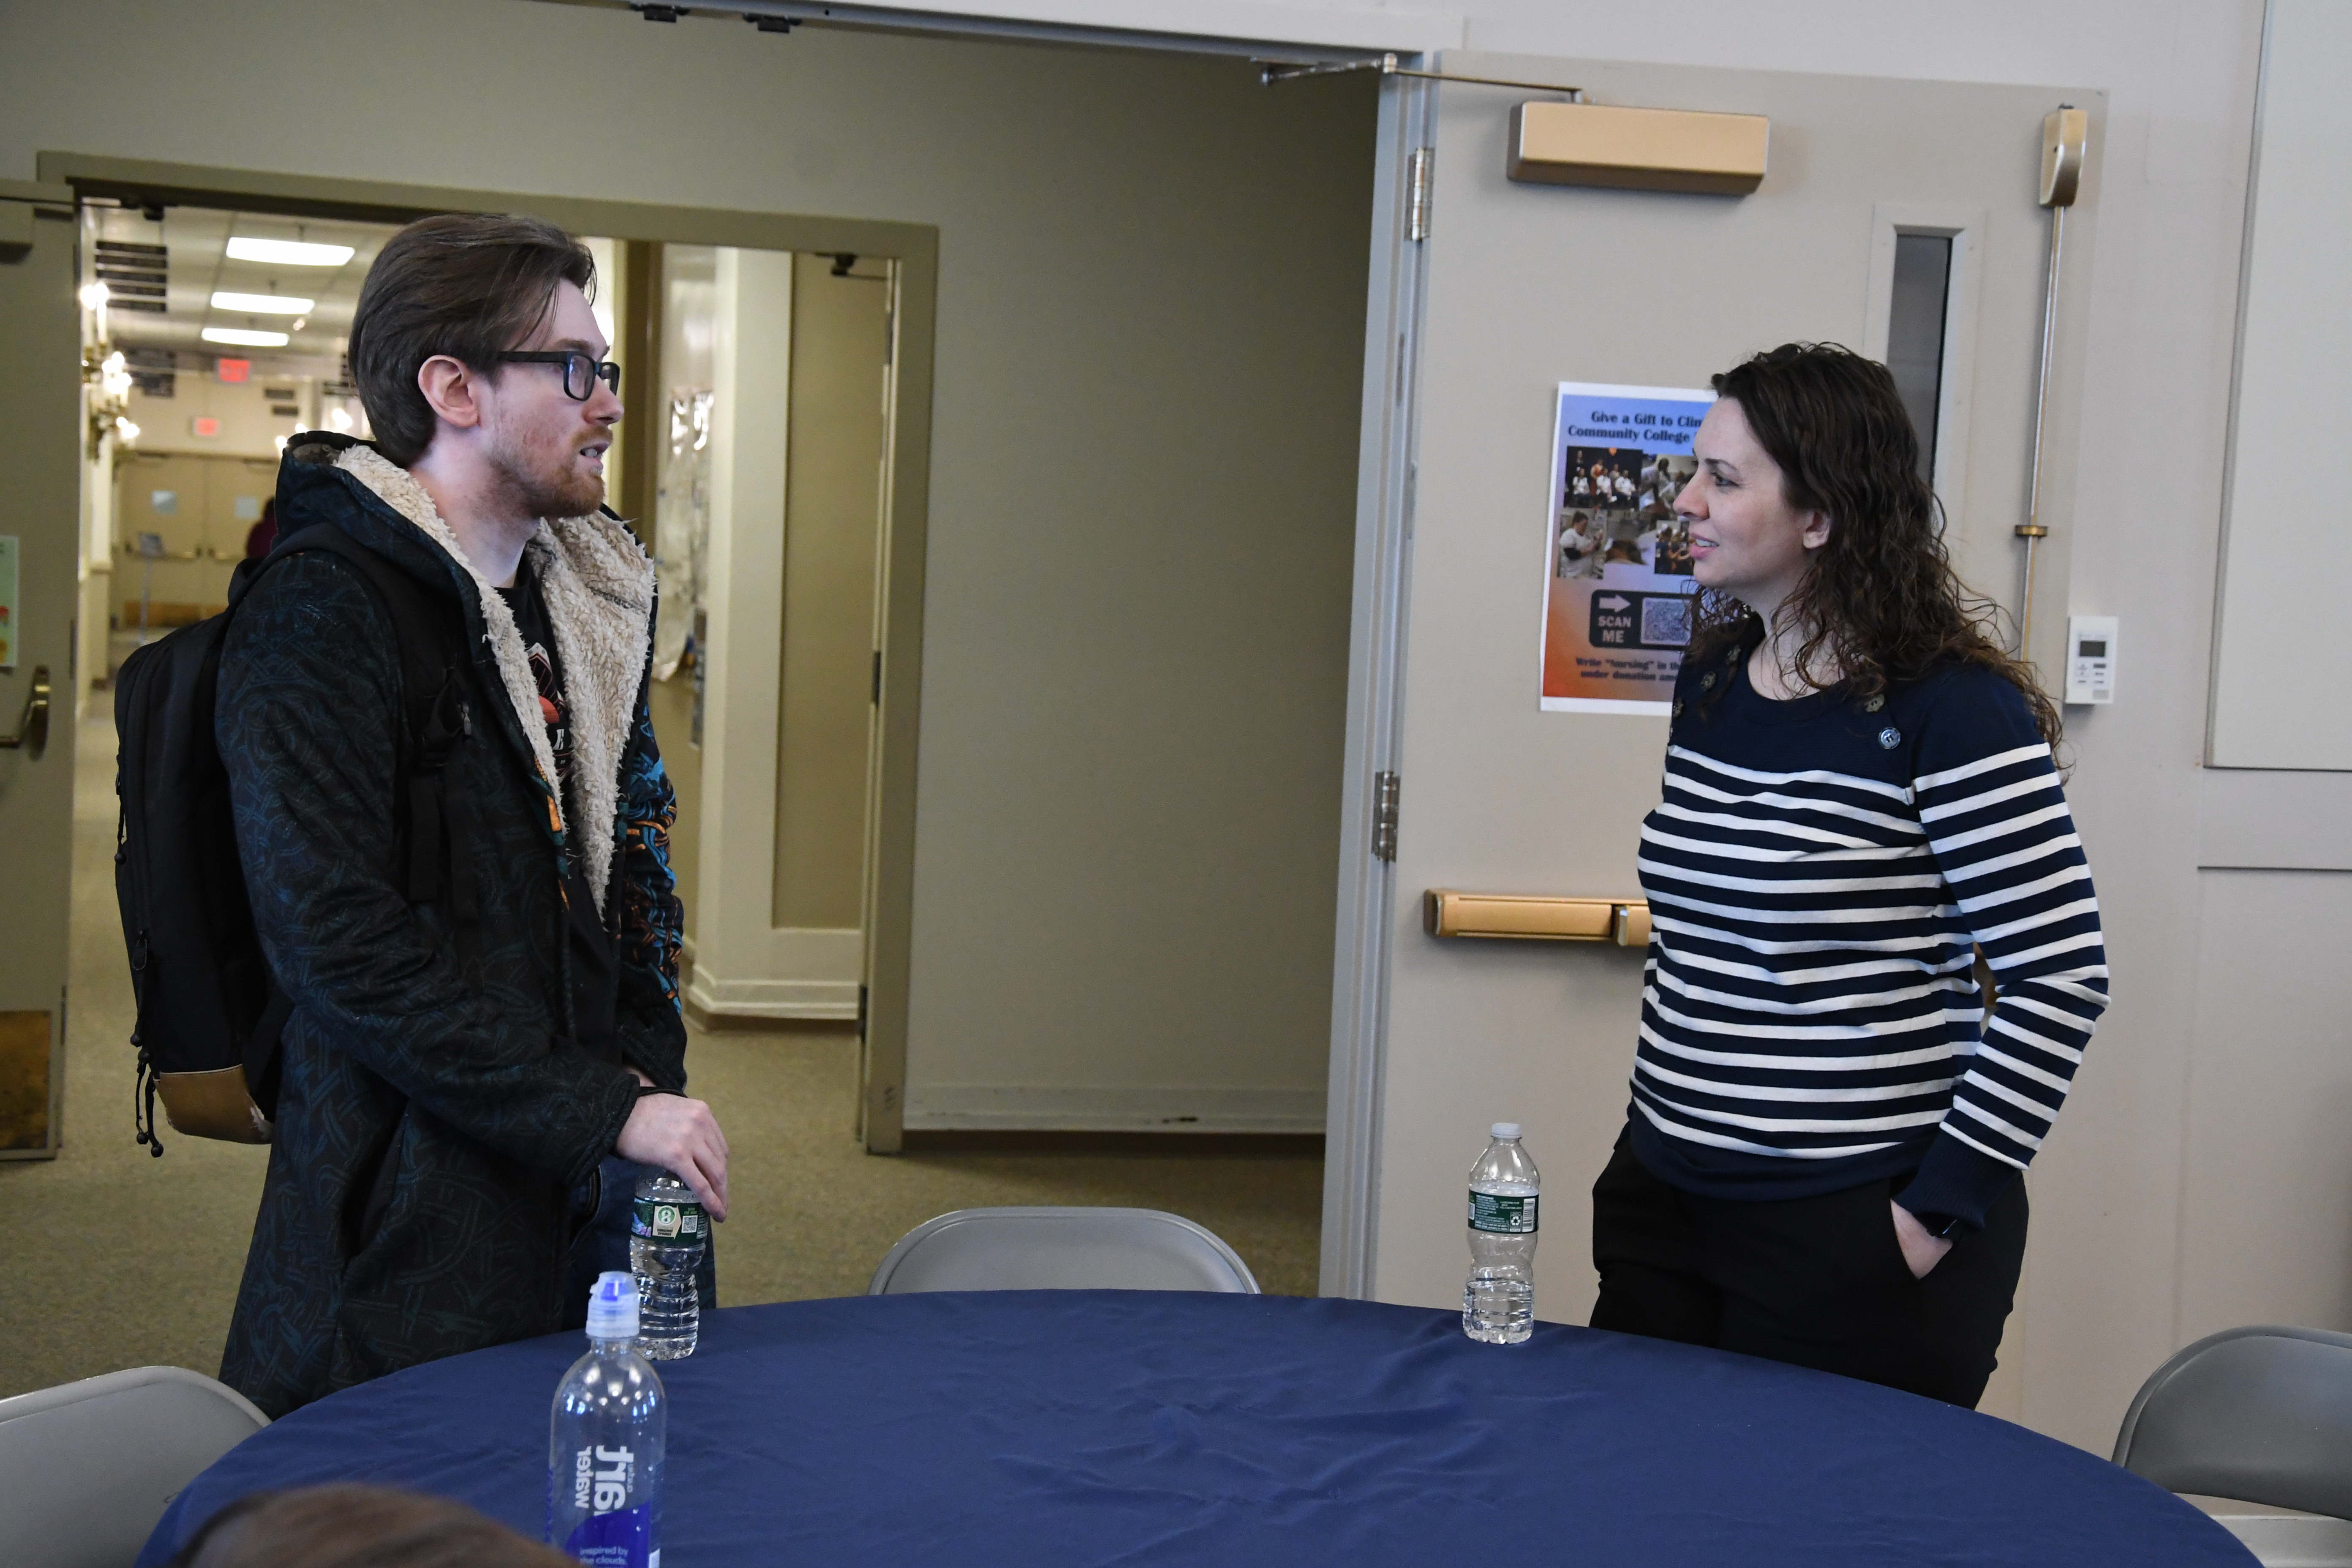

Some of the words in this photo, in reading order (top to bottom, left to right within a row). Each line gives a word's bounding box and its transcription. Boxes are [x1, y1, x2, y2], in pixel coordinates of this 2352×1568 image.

[1591, 411, 1618, 422] Give
[1622, 414, 1630, 423] a
[1634, 413, 1656, 425] Gift
[1661, 414, 1673, 426] to
[1568, 425, 1639, 441] Community
[1644, 429, 1690, 444] College
[1598, 615, 1631, 628] SCAN
[1602, 629, 1624, 643] ME
